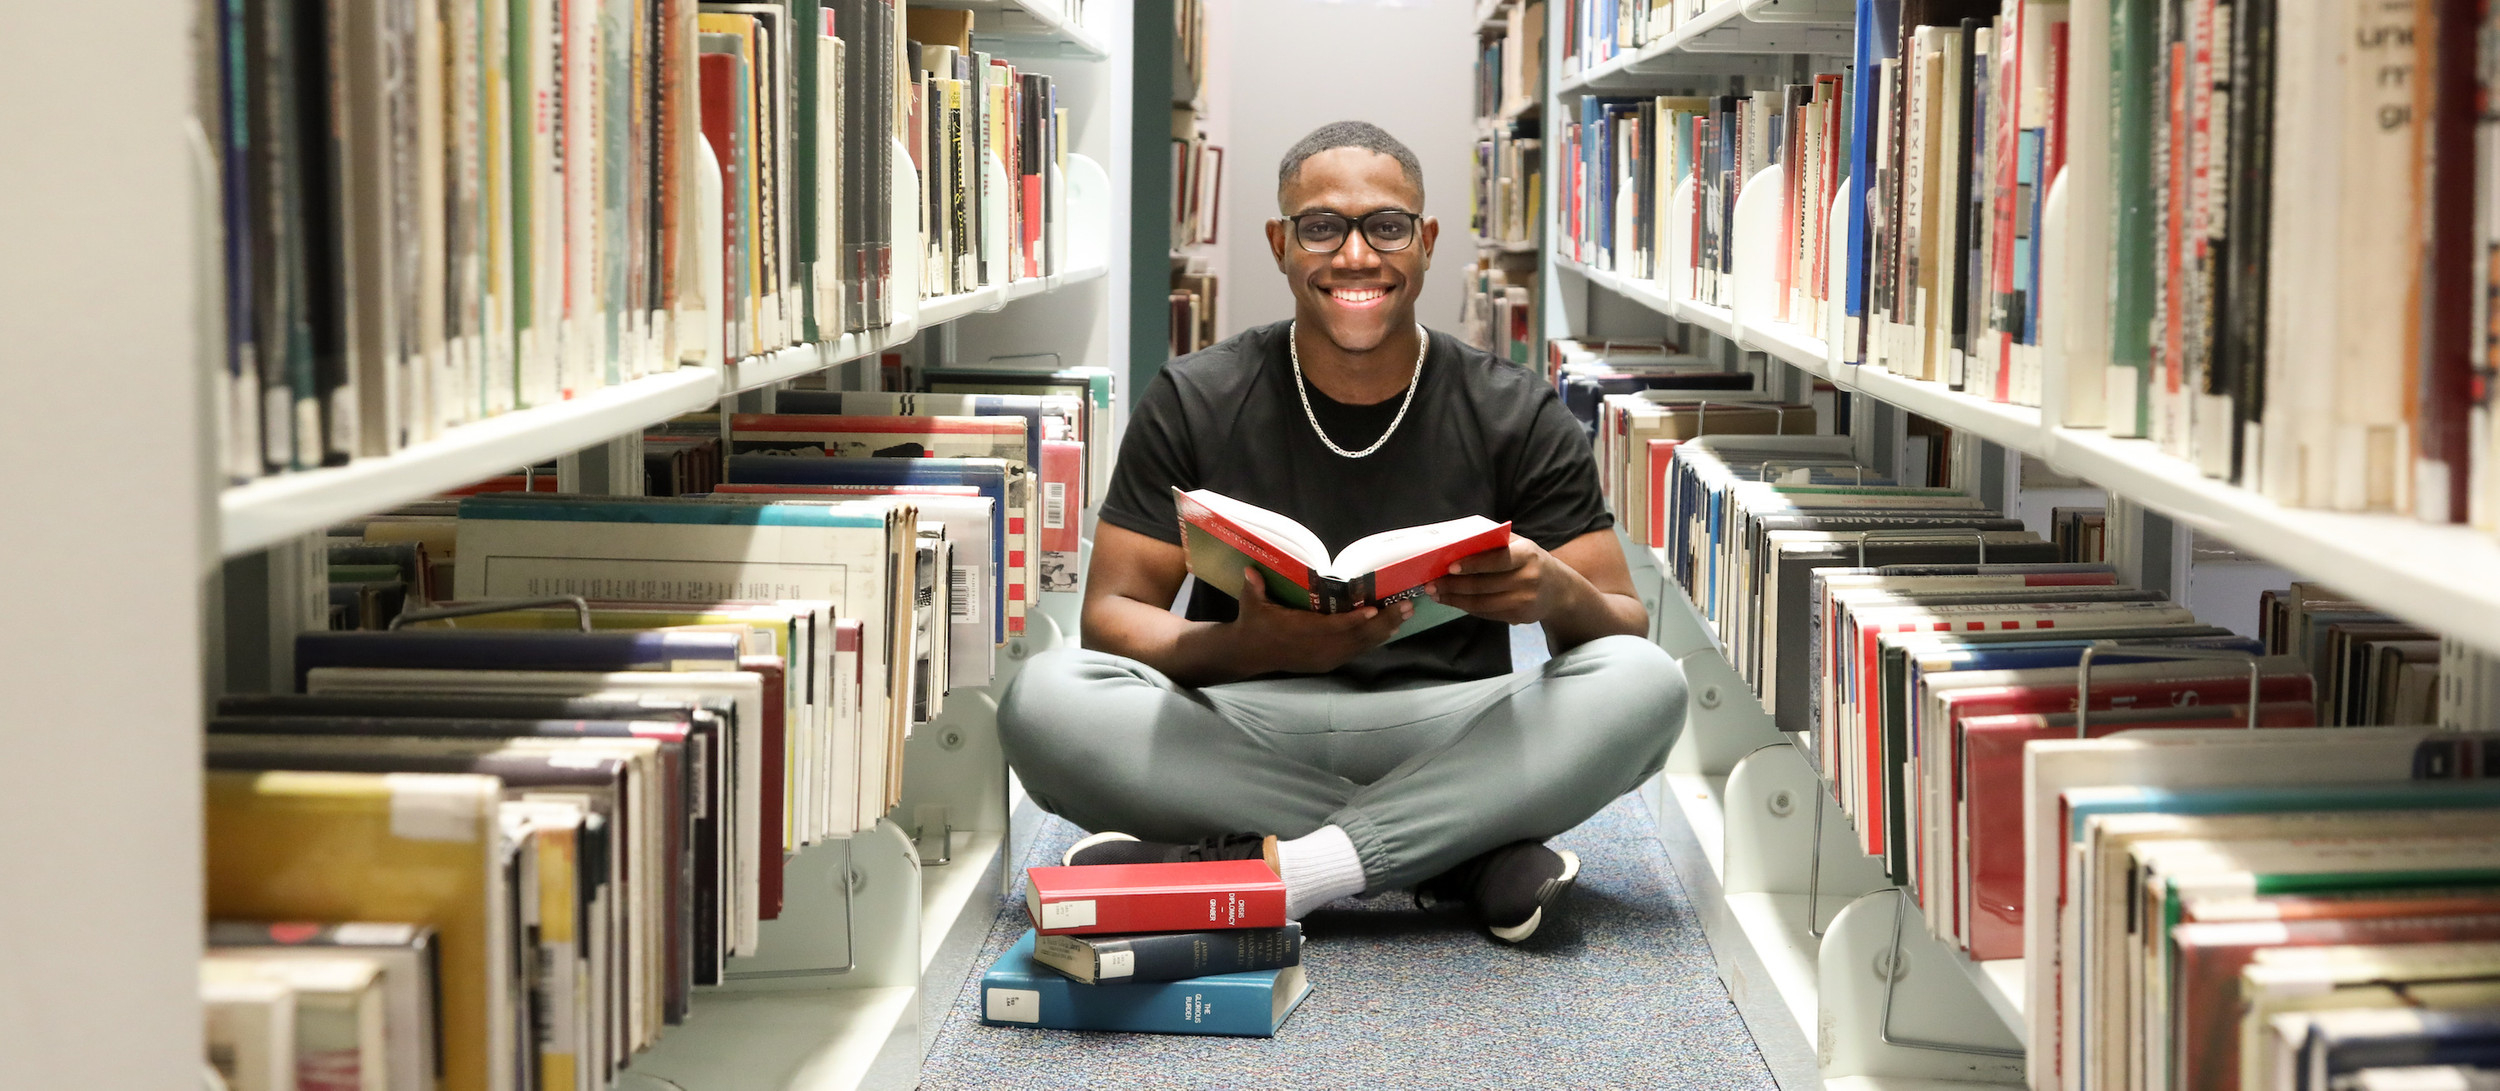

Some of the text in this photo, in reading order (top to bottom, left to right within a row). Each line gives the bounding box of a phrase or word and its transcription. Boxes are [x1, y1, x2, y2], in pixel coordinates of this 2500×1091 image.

[1914, 38, 1922, 87] THE
[1909, 98, 1920, 217] MEXICAN
[1889, 168, 1900, 299] CENTENNIAL
[1209, 898, 1217, 922] GRABER
[1228, 892, 1236, 926] DIPLOMACY
[1185, 996, 1193, 1021] BURDEN
[1194, 993, 1202, 1024] GLORIOUS
